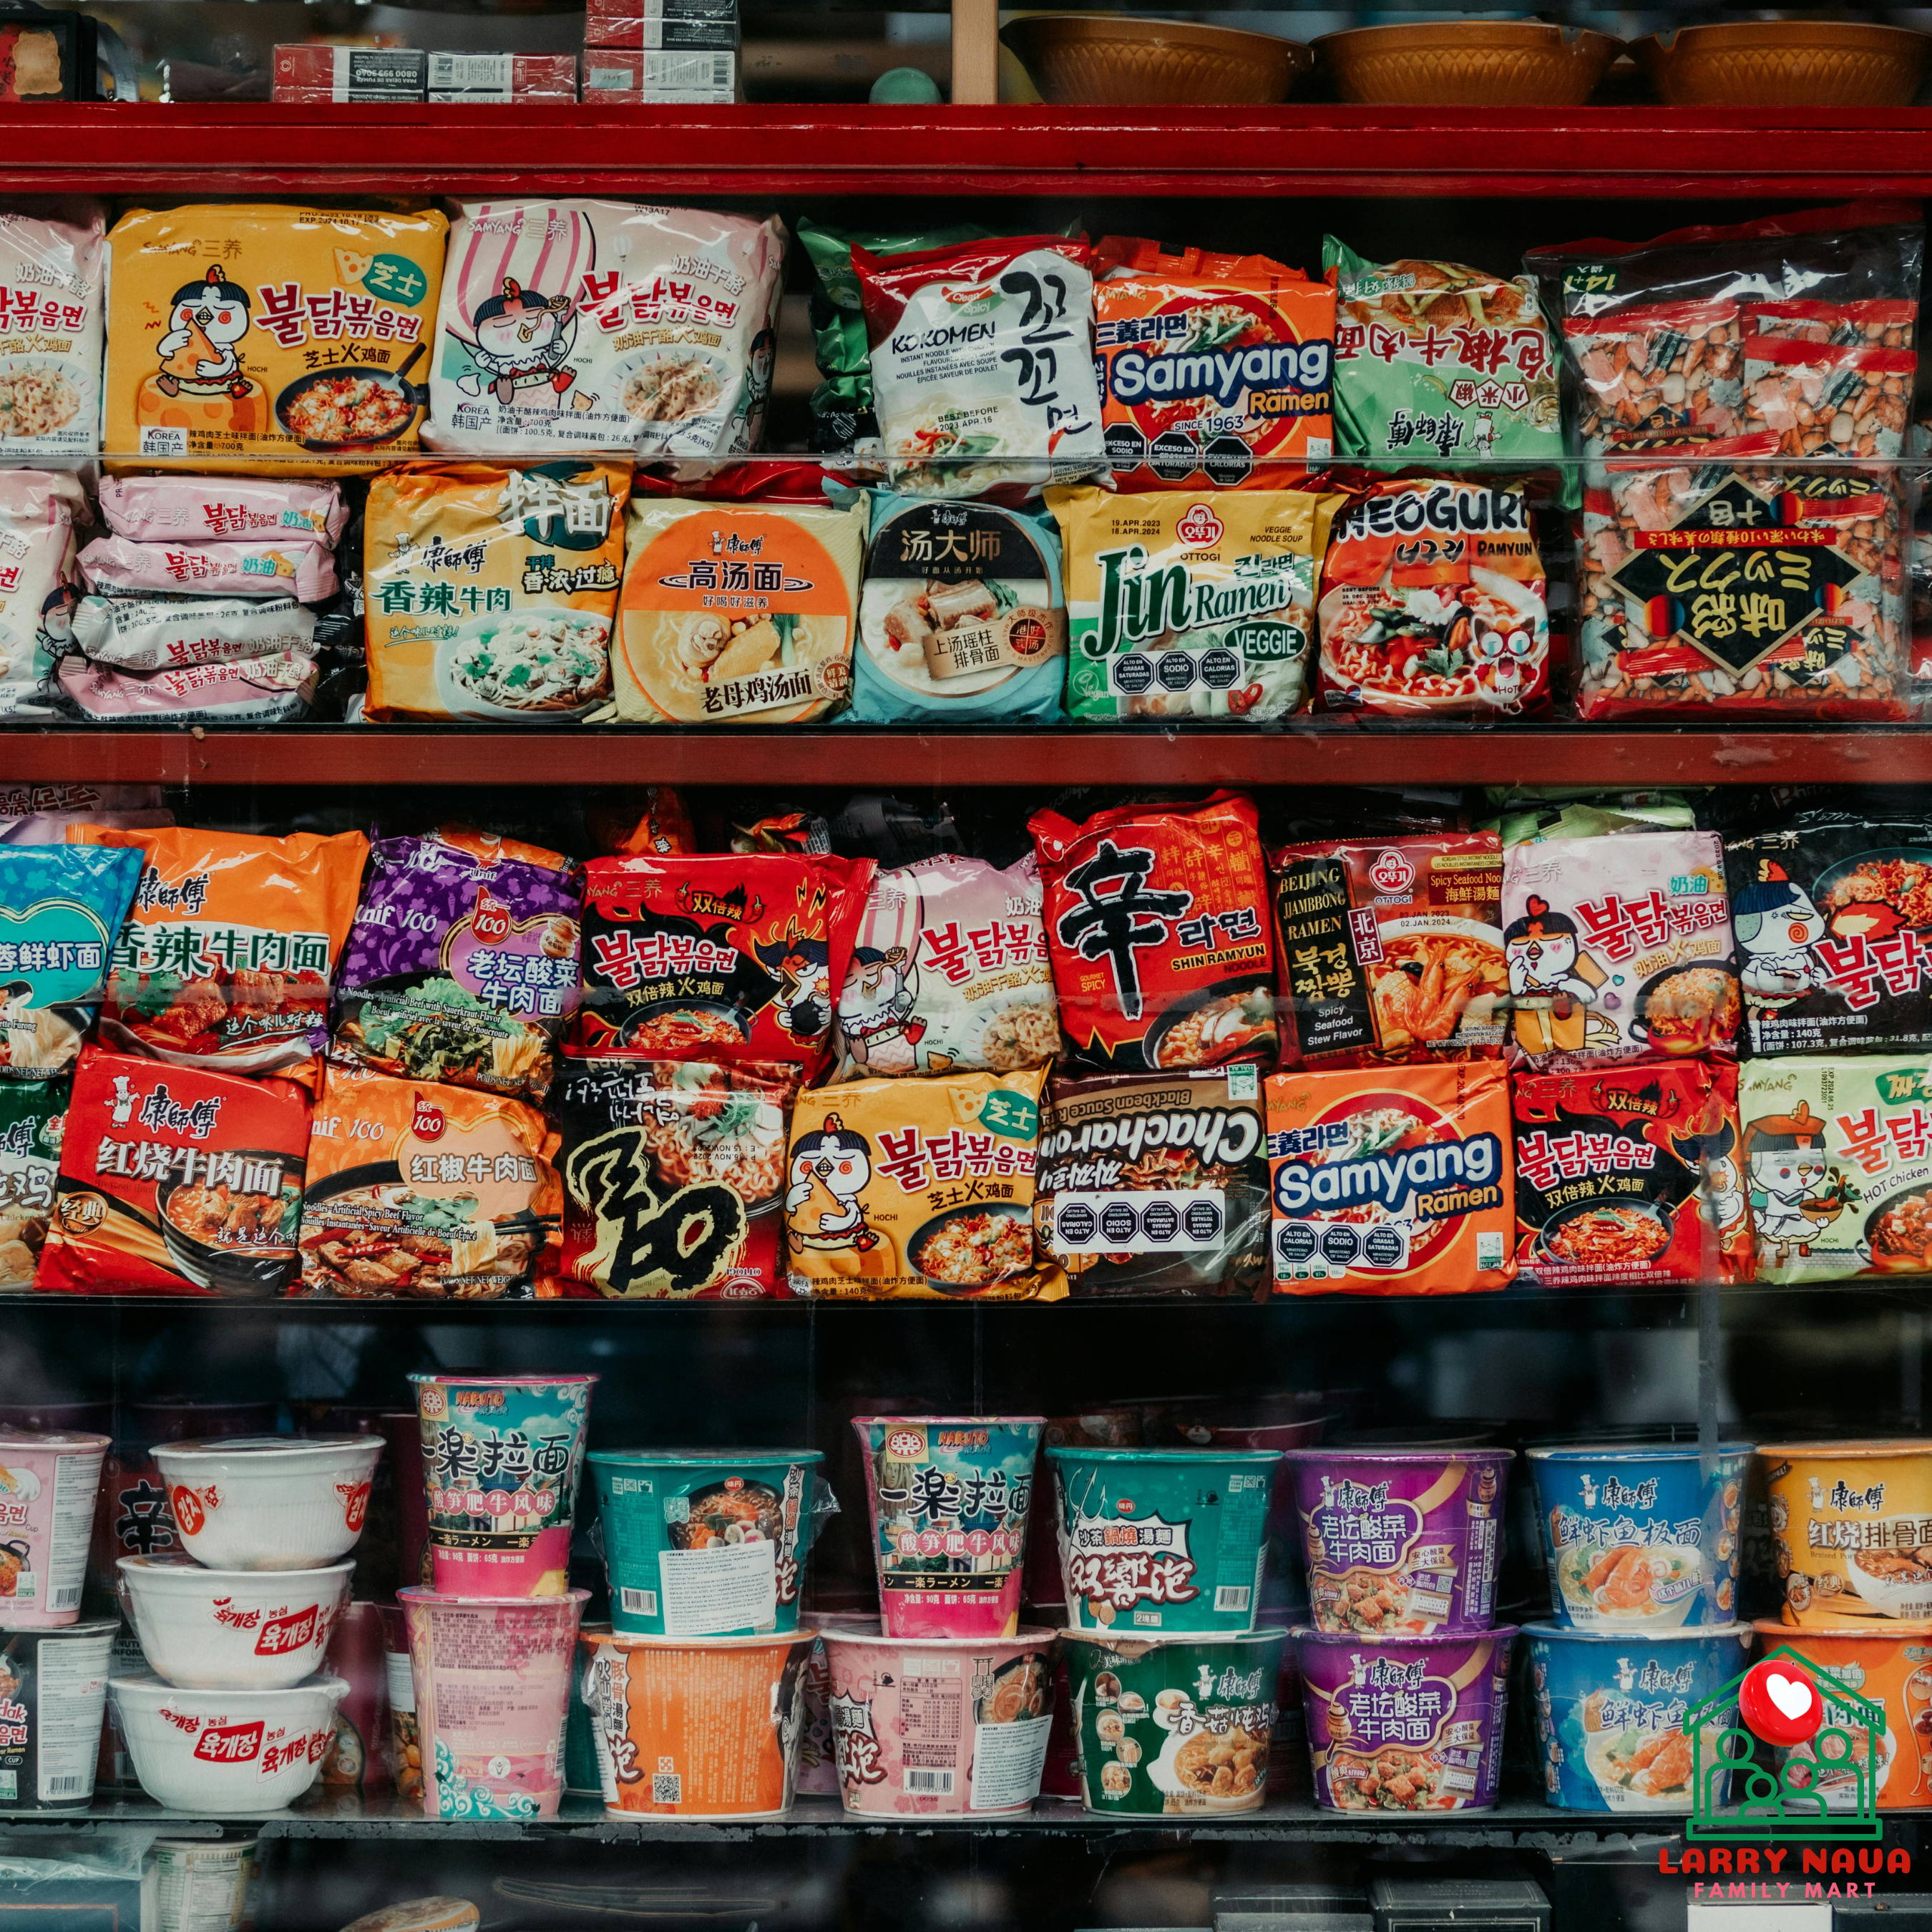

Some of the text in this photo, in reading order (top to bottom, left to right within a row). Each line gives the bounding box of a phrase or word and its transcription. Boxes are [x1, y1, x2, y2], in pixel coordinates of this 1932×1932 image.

[370, 262, 422, 298] 芝士
[670, 254, 746, 296] 奶油干酪
[577, 270, 740, 332] 불닭볶음면
[952, 292, 980, 302] Clean
[964, 302, 991, 316] Spicy
[255, 283, 421, 346] 불닭볶음면
[892, 321, 995, 354] KOKOMEN
[303, 343, 391, 369] 芝士火鸡面
[896, 370, 924, 381] NOUILLES
[976, 356, 997, 365] SOUPE
[900, 348, 950, 364] INSTANT NOODLE
[939, 371, 964, 379] SAVEUR
[975, 364, 998, 374] POULET
[1114, 344, 1328, 399] Samyang
[457, 404, 489, 414] KOREA
[938, 406, 998, 422] BEST BEFORE
[1251, 391, 1329, 414] Ramen
[452, 414, 492, 430] 韩国产
[1174, 415, 1244, 432] SINCE 1963
[147, 431, 180, 441] KOREA
[202, 502, 278, 535] 불닭볶음면
[1111, 519, 1161, 528] 19.APR.2023
[421, 536, 487, 574] 康師傅
[726, 532, 763, 557] 康師傅
[899, 529, 1001, 562] 汤大师
[1180, 553, 1221, 562] OTTOGI
[1478, 541, 1533, 557] RAMYUN
[240, 557, 277, 576] 奶油
[688, 560, 784, 591] 高汤面
[922, 566, 984, 575] 好面从汤开始
[1234, 553, 1294, 576] 진라면
[1659, 550, 1812, 592] ミックス
[369, 580, 512, 617] 香辣牛肉
[703, 595, 769, 609] 好喝好滋养
[1081, 545, 1288, 657] Jin Ramen
[166, 638, 243, 665] 불닭볶음면
[933, 629, 995, 656] 上汤瑶柱
[1234, 629, 1297, 655] VEGGIE
[954, 645, 1000, 670] 排骨面
[700, 668, 813, 713] 老母鸡汤面
[1279, 867, 1341, 894] BEIJING
[1445, 886, 1500, 902] 海鮮湯麵
[1669, 877, 1708, 895] 奶油
[692, 892, 743, 920] 双倍辣
[1283, 894, 1346, 919] JJAMBBONG
[1374, 895, 1413, 904] OTTOGI
[1399, 909, 1450, 918] 03.JAN.2023
[1400, 918, 1450, 927] 02.JAN.2024
[1574, 891, 1727, 961] 불닭볶음면
[1058, 839, 1194, 1020] 辛
[1176, 907, 1262, 949] 라면
[1288, 915, 1342, 941] RAMEN
[112, 922, 330, 980] 香辣牛肉面
[592, 930, 738, 990] 불닭볶음면
[1171, 943, 1267, 972] SHIN RAMYUN
[1633, 939, 1721, 978] 奶油火鸡面
[468, 950, 579, 988] 老坛酸菜
[1224, 958, 1267, 974] NOODLE
[482, 979, 565, 1015] 牛肉面
[627, 977, 725, 1009] 双倍辣火鸡面
[1081, 980, 1106, 992] SPICY
[1314, 1017, 1354, 1031] Seafood
[1318, 1005, 1345, 1018] Spicy
[1307, 1028, 1363, 1046] Stew Flavor
[140, 1084, 220, 1139] 康師傅
[986, 1098, 1037, 1132] 芝士
[1070, 1090, 1191, 1116] Blackbean Sauce
[1608, 1090, 1658, 1116] 双倍辣
[415, 1115, 441, 1132] 100
[1039, 1112, 1259, 1163] Chacharon
[95, 1137, 283, 1198] 红烧牛肉面
[411, 1153, 535, 1182] 红椒牛肉面
[875, 1128, 1037, 1193] 불닭볶음면
[1279, 1138, 1493, 1209] Samyang
[1518, 1131, 1656, 1191] 불닭볶음면
[928, 1180, 1015, 1211] 芝士火鸡面
[1545, 1175, 1644, 1209] 双倍辣火鸡面
[1863, 1166, 1929, 1204] HOT Chicken
[1418, 1186, 1498, 1217] Ramen
[456, 1391, 505, 1406] NARUTO
[938, 1430, 989, 1446] NARUTO
[433, 1488, 554, 1513] 酸笋肥牛风味
[1338, 1479, 1387, 1512] 康師傅
[1602, 1476, 1658, 1511] 康師傅
[1830, 1480, 1885, 1513] 康師傅
[1078, 1526, 1173, 1547] 沙茶鍋燒湯麵
[1322, 1513, 1407, 1539] 老坛酸菜
[1558, 1514, 1702, 1549] 鲜虾鱼板面
[900, 1533, 1020, 1553] 酸笋肥牛风味
[1329, 1540, 1396, 1563] 牛肉面
[260, 1619, 316, 1651] 육개장
[1217, 1667, 1262, 1701] 康師傅
[1371, 1657, 1425, 1690] 康師傅
[1639, 1660, 1694, 1694] 康師傅
[1349, 1690, 1441, 1717] 老坛酸菜
[1169, 1701, 1279, 1735] 香菇炖鸡
[1357, 1717, 1430, 1741] 牛肉面
[200, 1730, 258, 1759] 육개장
[261, 1734, 307, 1774] 육개장
